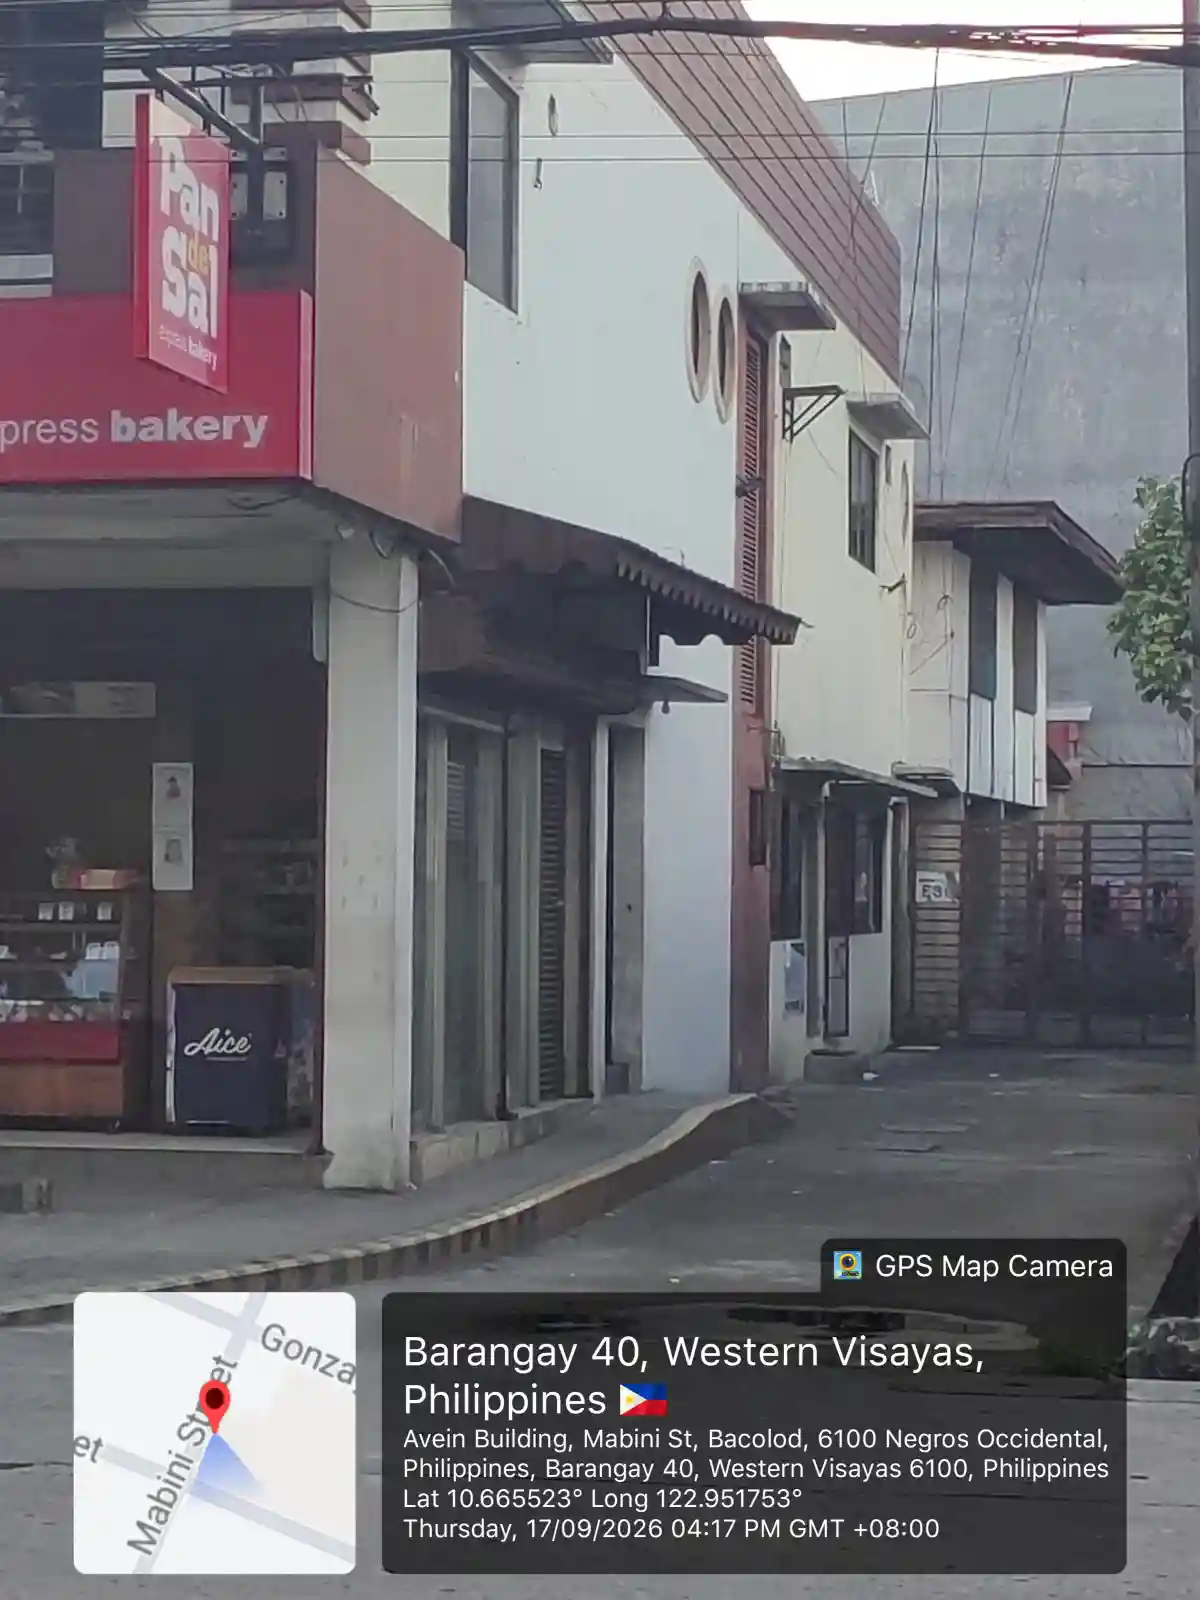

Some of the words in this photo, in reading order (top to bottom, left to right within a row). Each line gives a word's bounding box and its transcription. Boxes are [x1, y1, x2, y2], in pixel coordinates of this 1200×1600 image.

[159, 137, 219, 242] Pan
[187, 232, 211, 276] de
[161, 225, 218, 340] Sal
[110, 407, 268, 448] bakery
[184, 1027, 252, 1056] Aice
